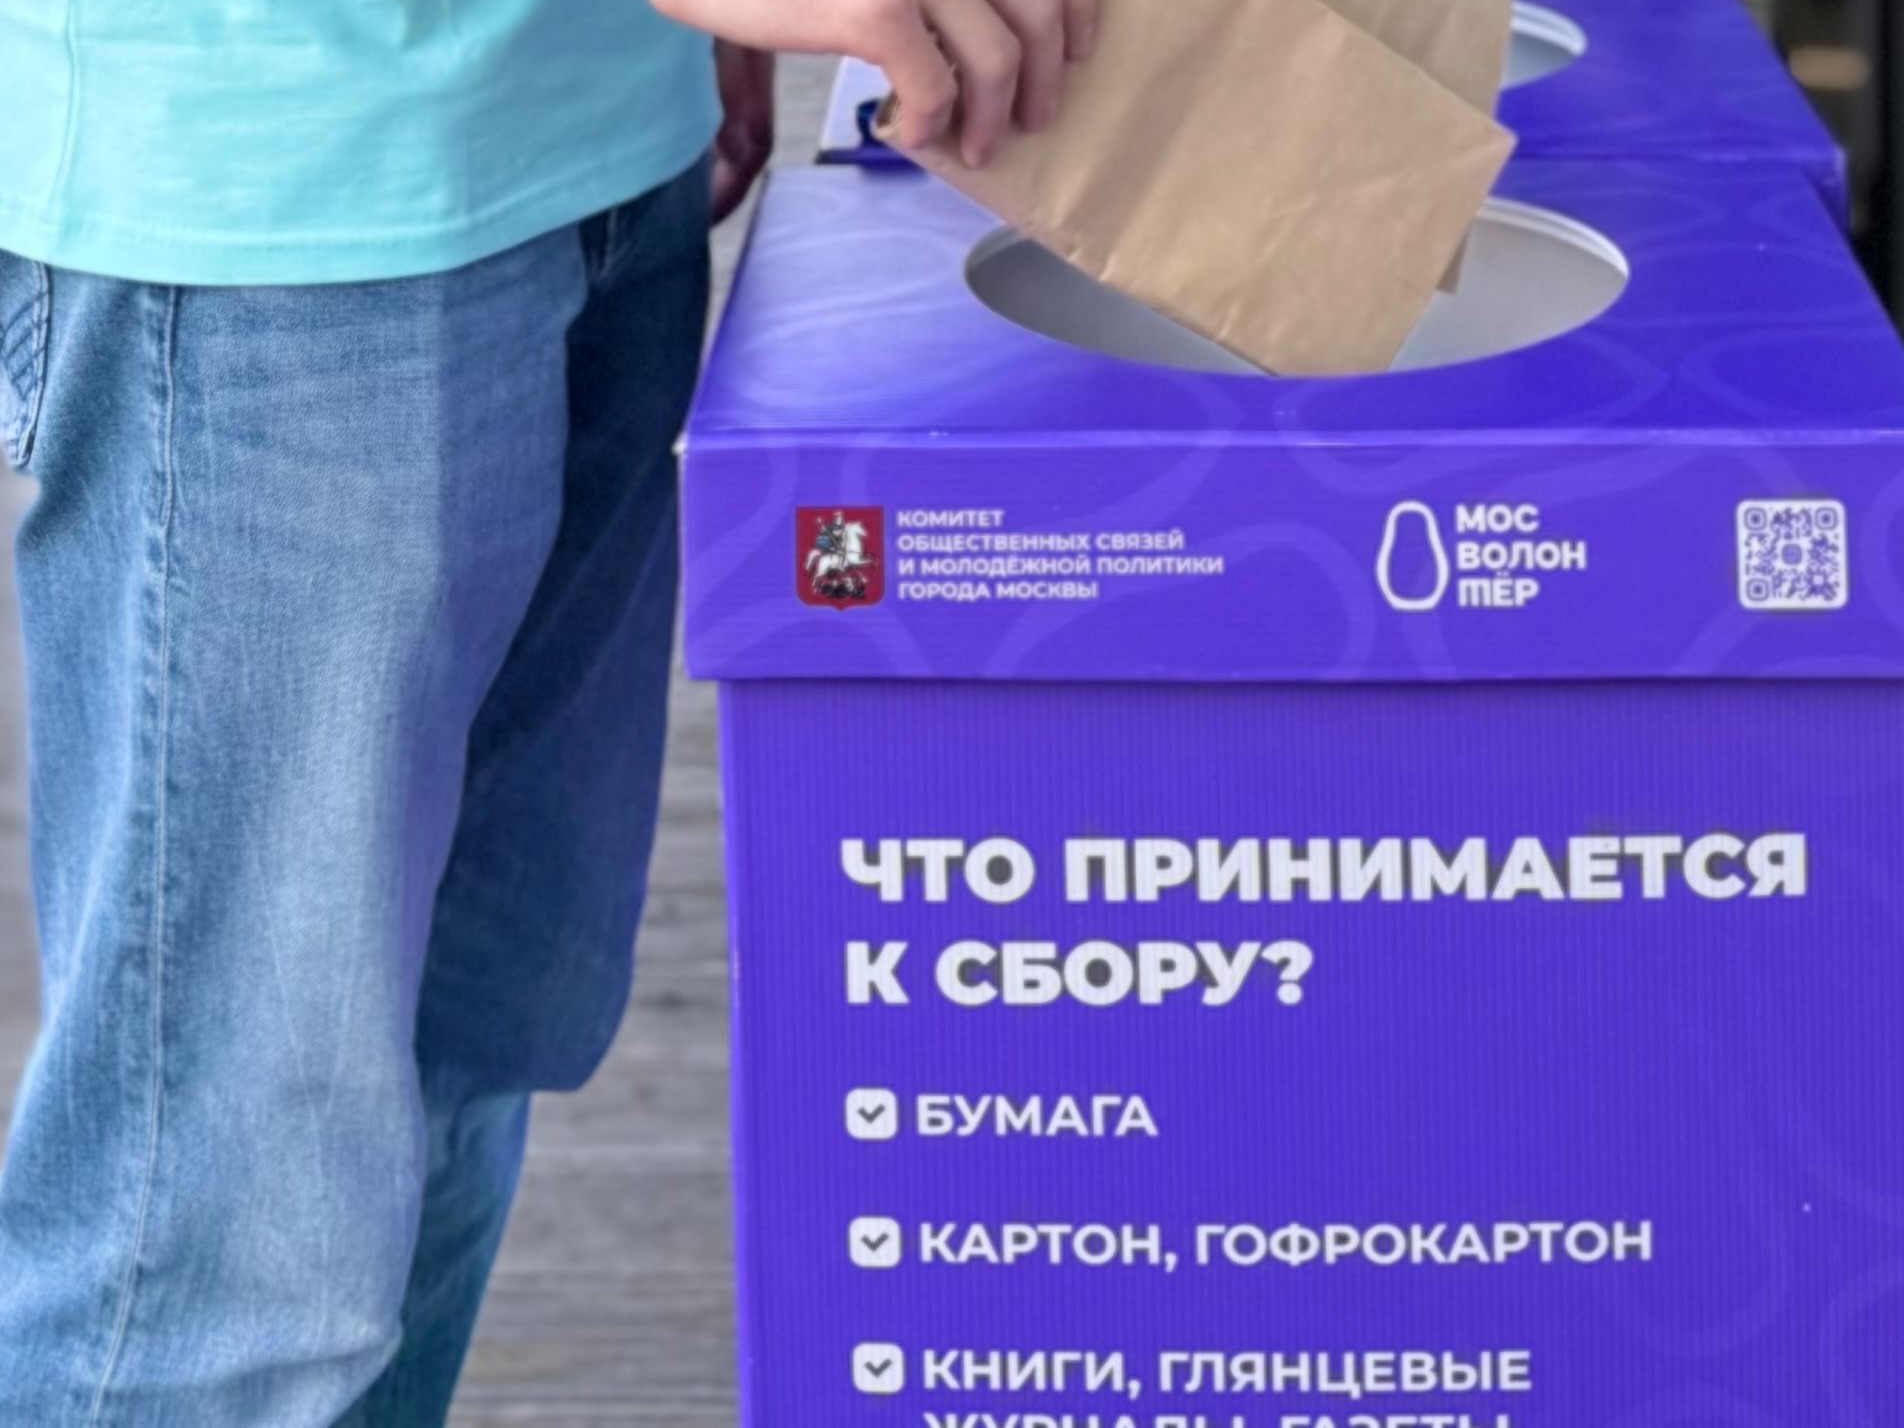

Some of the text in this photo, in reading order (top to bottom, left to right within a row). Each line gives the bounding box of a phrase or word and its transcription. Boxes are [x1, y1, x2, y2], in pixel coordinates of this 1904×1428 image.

[897, 509, 1005, 528] КОМИТЕТ
[1455, 503, 1540, 534] МОС
[897, 529, 1185, 553] ОБЩЕСТВЕННЫХ СВЯЗЕЙ
[1456, 540, 1587, 571] ВОЛОН
[899, 553, 1224, 578] И МОЛОДЁЖНОЙ ПОЛИТИКИ
[898, 580, 1098, 602] ГОРОДА МОСКВЫ
[841, 833, 1807, 903] ЧТО ПРИНИМАЕТСЯ
[846, 940, 1313, 1006] К СБОРУ?
[916, 1094, 1158, 1136] БУМАГА
[919, 1221, 1652, 1272] КАРТОН, ГОФРОКАРТОН
[922, 1350, 1532, 1399] КНИГИ, ГЛЯНЦЕВЫЕ
